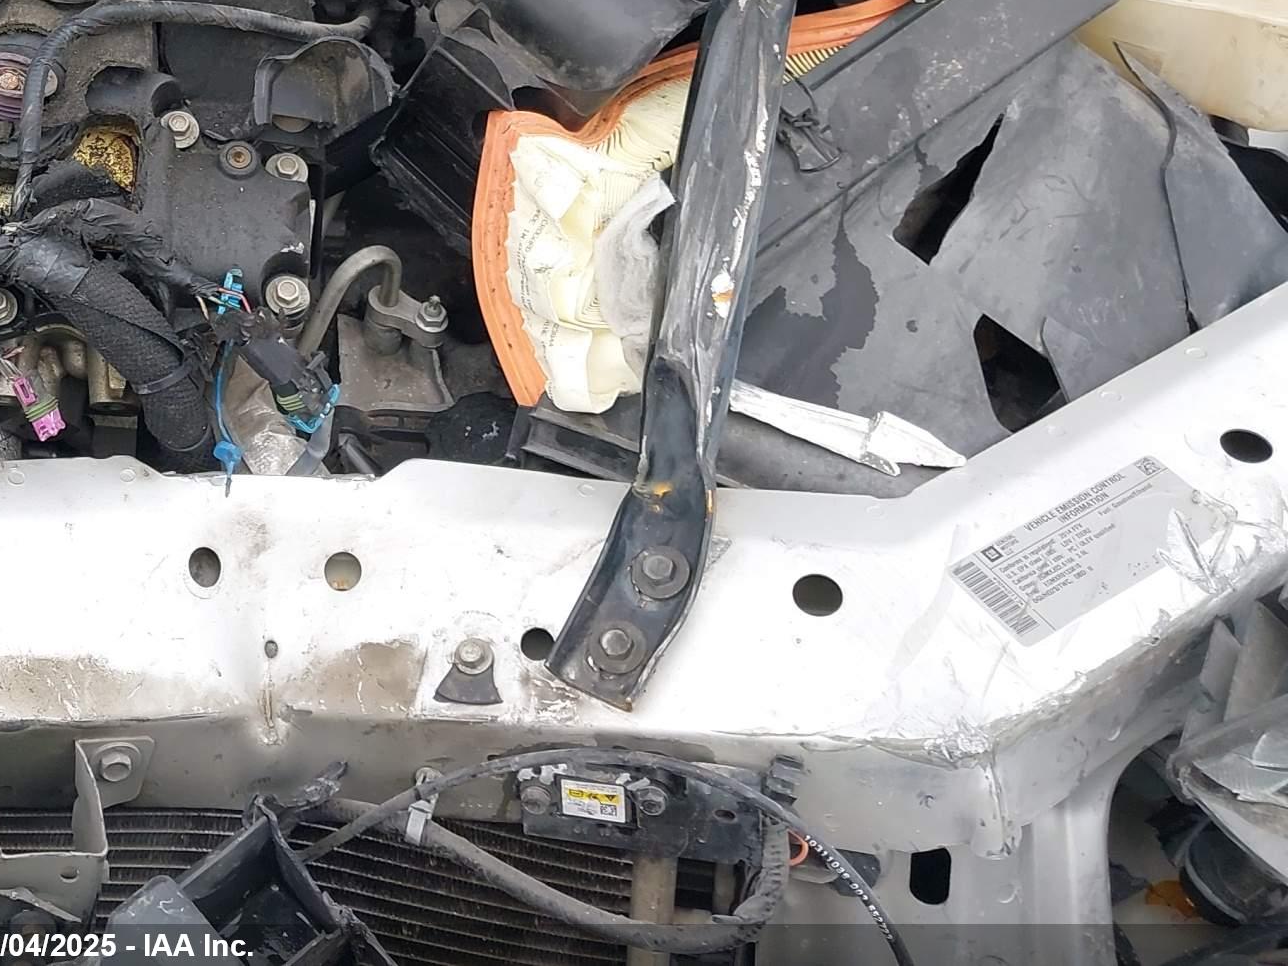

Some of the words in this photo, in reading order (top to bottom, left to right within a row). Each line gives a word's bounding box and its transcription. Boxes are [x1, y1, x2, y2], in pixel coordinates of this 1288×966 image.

[1024, 512, 1056, 532] VEHICLE
[1055, 491, 1092, 514] EMISSION
[1090, 472, 1125, 494] CONTROL
[1058, 492, 1109, 523] INFORMATION
